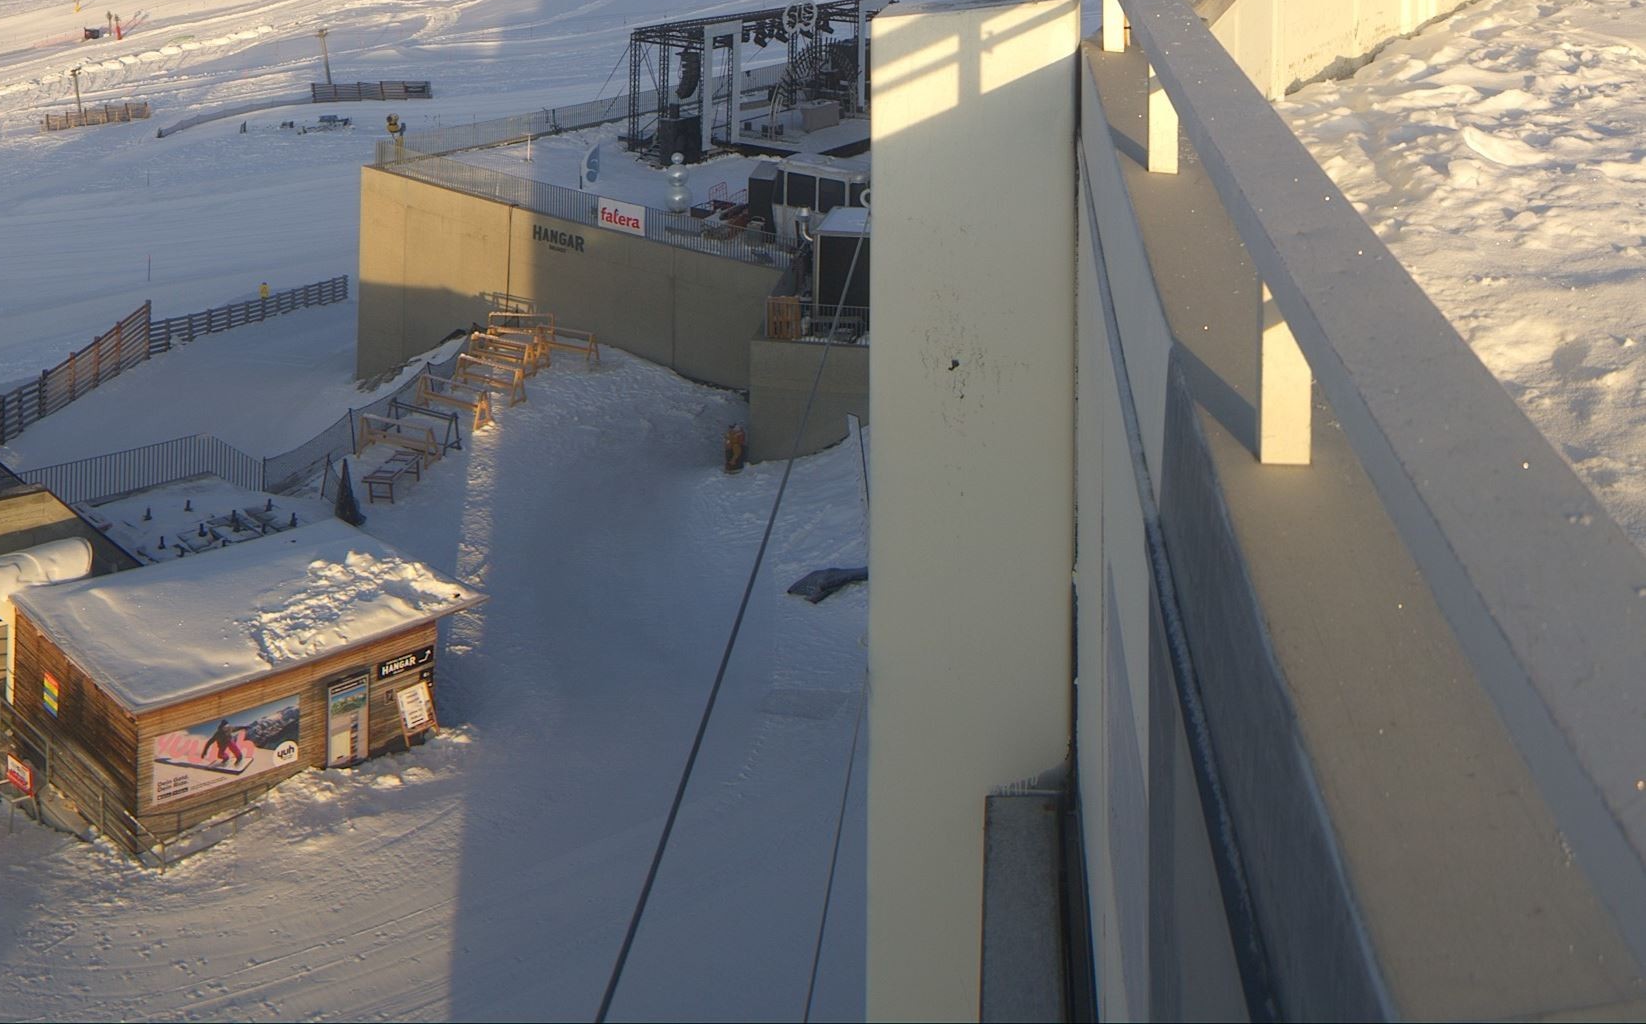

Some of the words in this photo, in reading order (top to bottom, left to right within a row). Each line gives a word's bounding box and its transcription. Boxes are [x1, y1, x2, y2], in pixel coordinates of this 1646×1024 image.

[600, 207, 641, 229] falera
[532, 224, 584, 253] HANGAR
[381, 656, 417, 676] HANGAR
